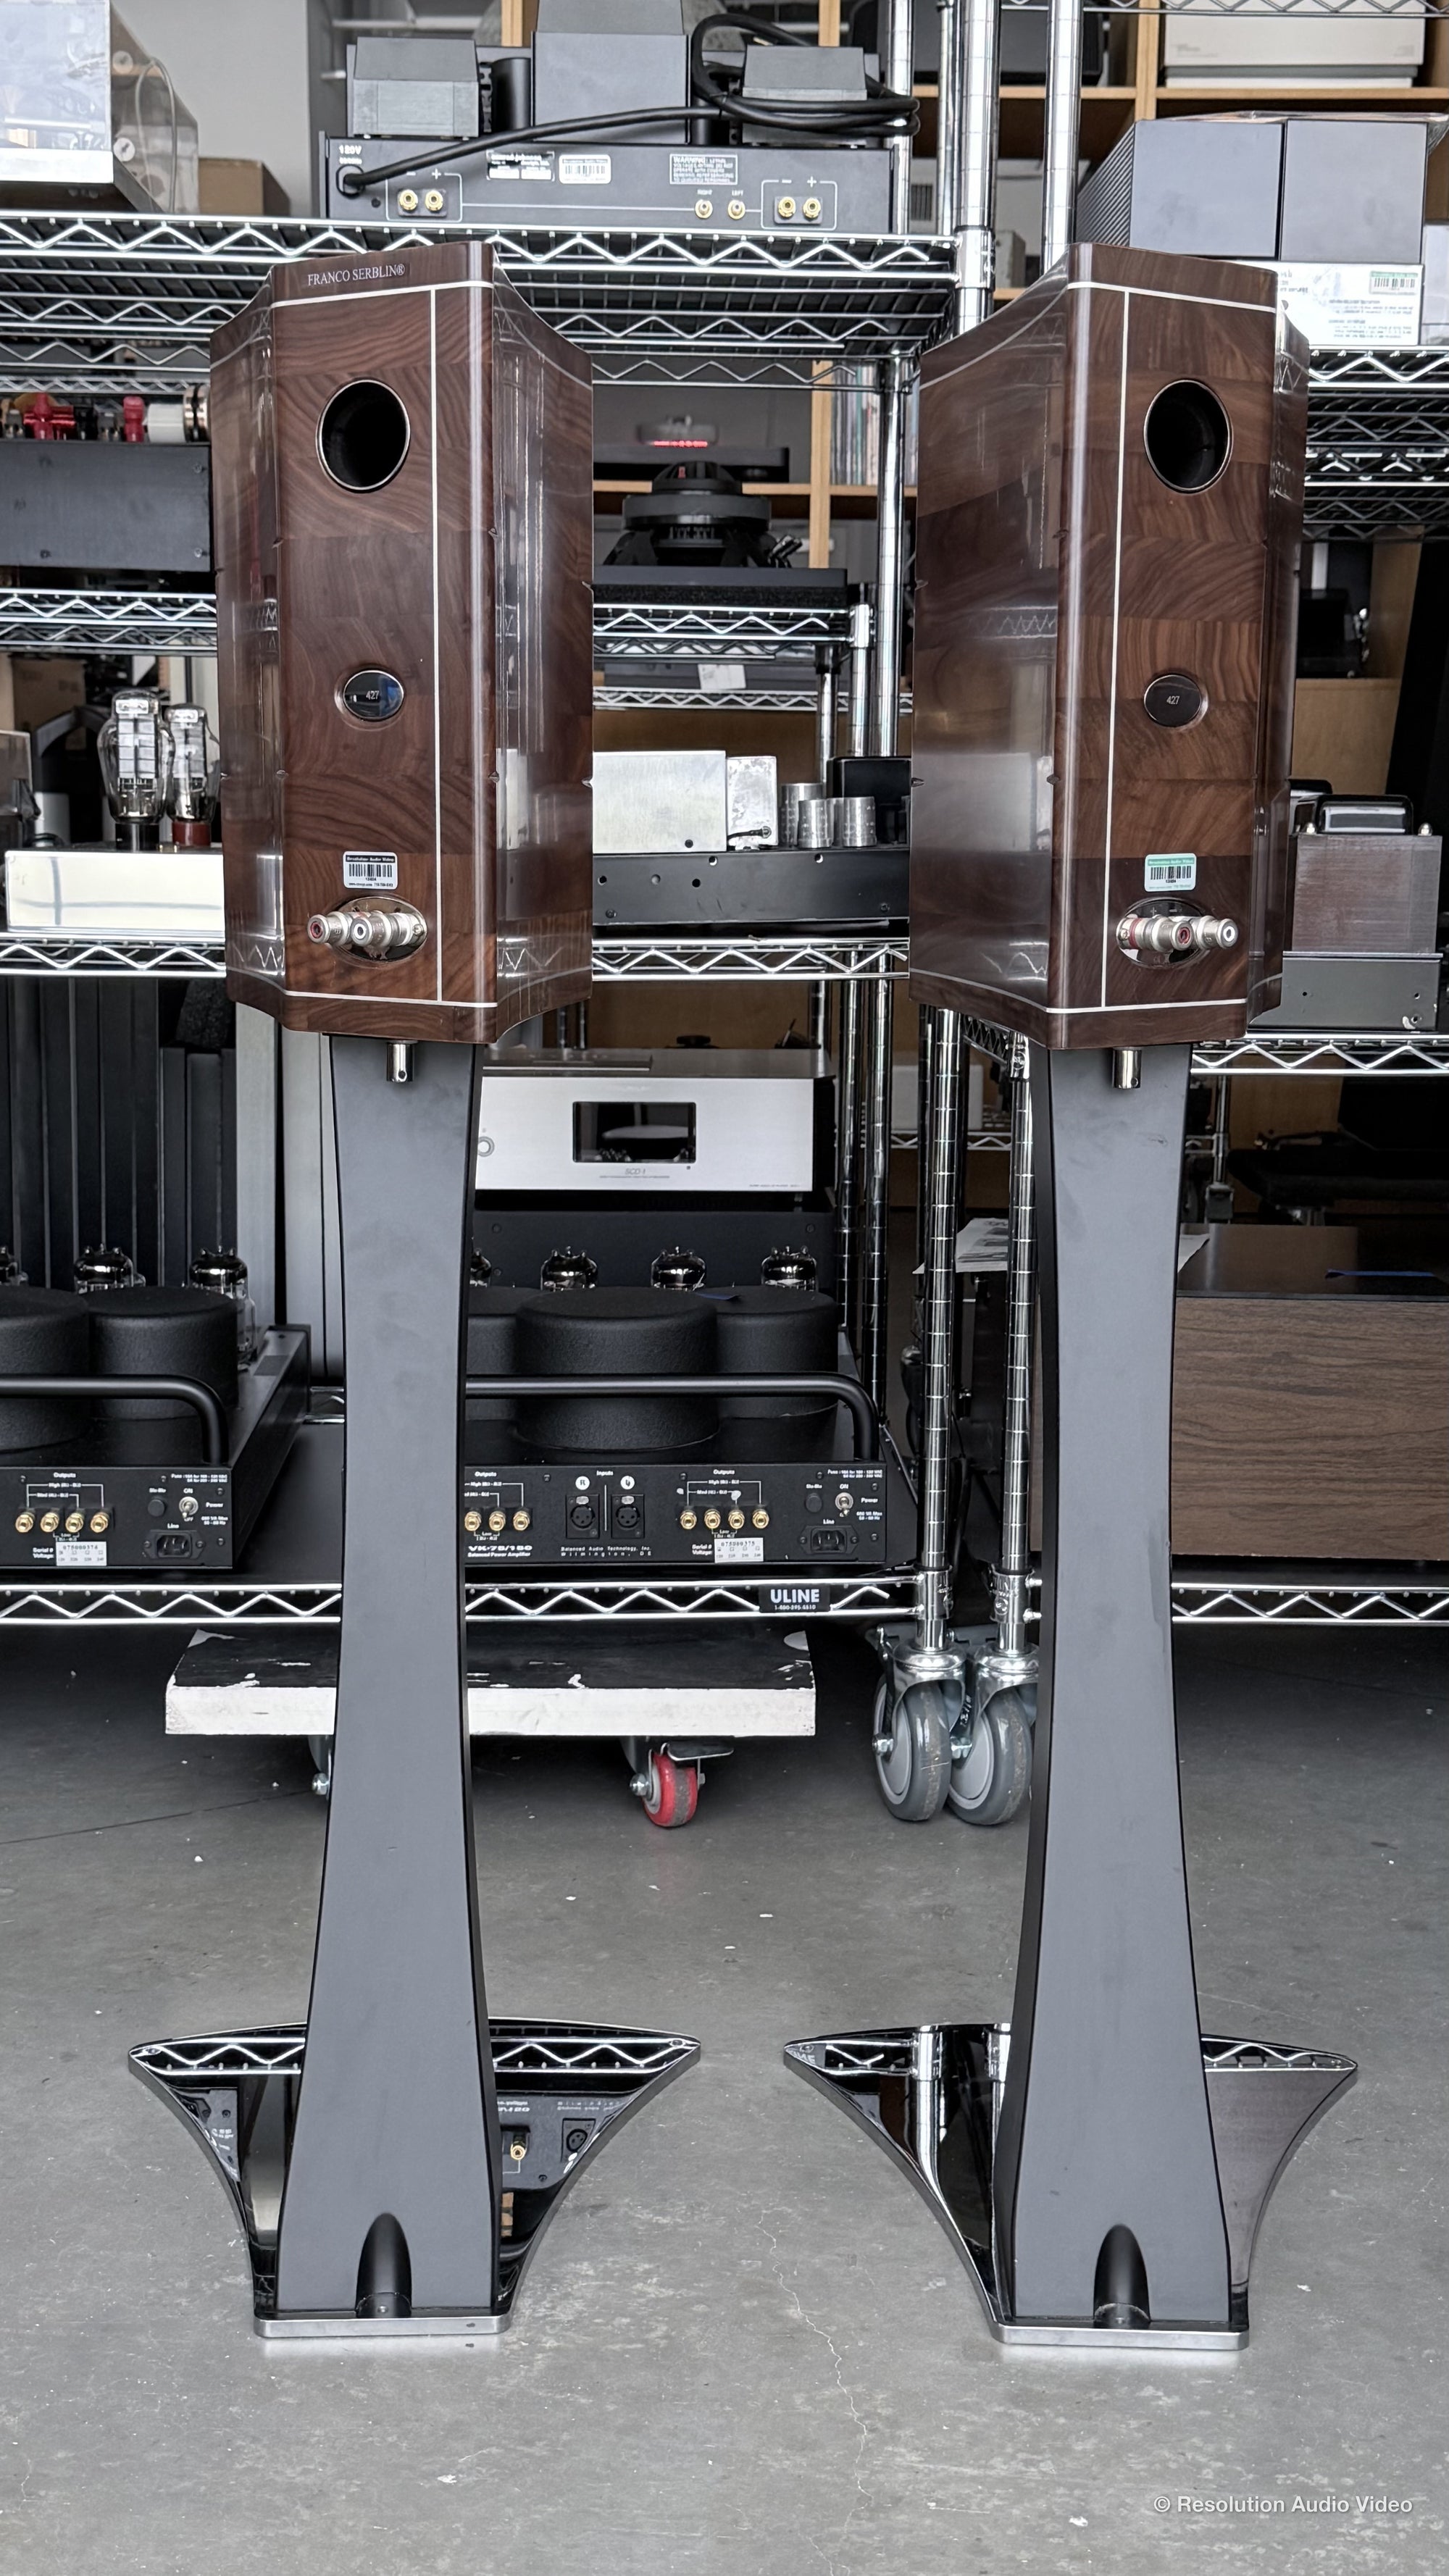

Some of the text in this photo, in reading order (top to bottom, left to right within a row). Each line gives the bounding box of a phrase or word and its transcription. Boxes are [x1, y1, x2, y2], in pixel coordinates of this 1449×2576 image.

[307, 269, 351, 286] FRANCO
[365, 690, 380, 700] 427
[1166, 695, 1180, 705] 427
[770, 1589, 820, 1603] ULINE
